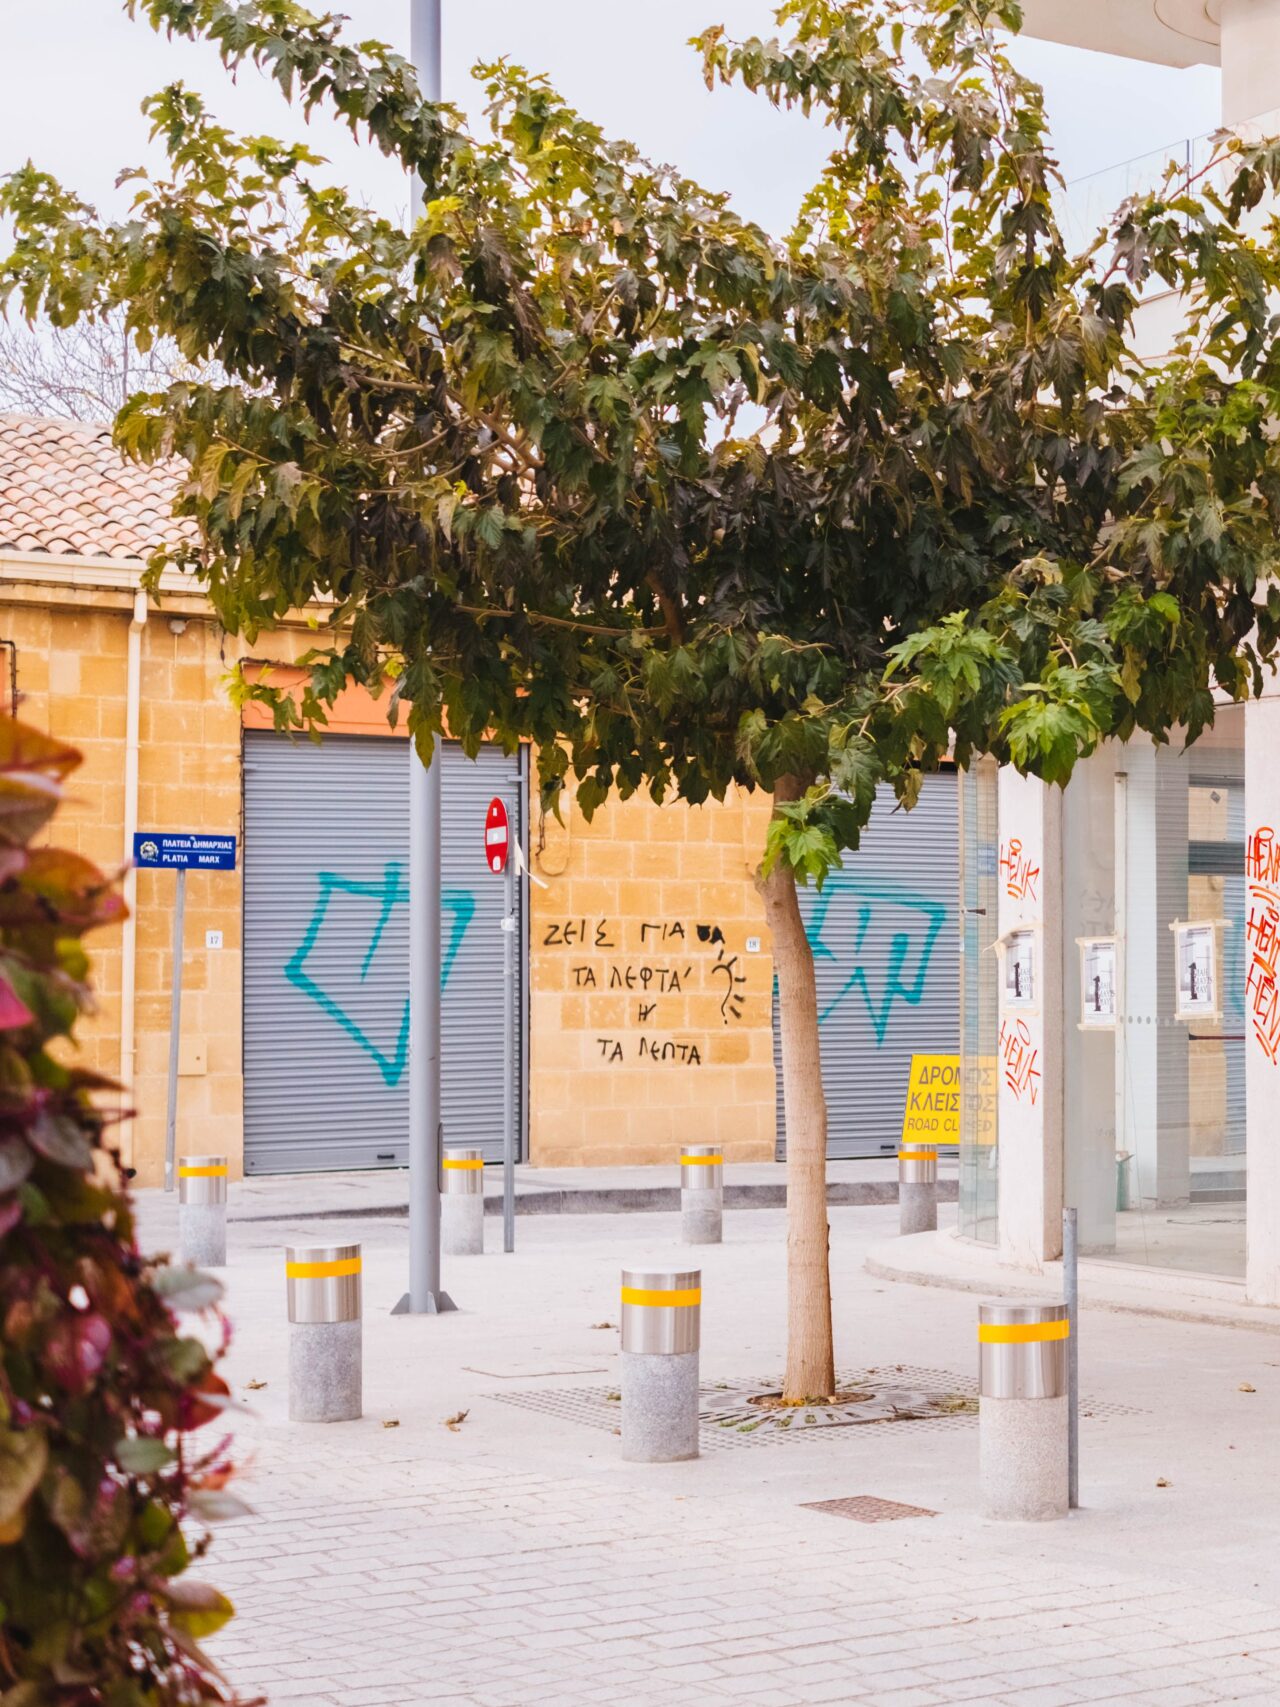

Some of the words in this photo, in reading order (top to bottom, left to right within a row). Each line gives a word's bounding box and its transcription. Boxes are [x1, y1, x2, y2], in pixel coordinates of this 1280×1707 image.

[162, 839, 191, 848] ΠΛΑΤΕΙΑ
[192, 840, 233, 850] ΔΗΜΑΡΧΙΑΣ
[162, 854, 189, 863] PLATIA
[198, 855, 220, 864] MARX
[907, 1116, 939, 1132] ROAD
